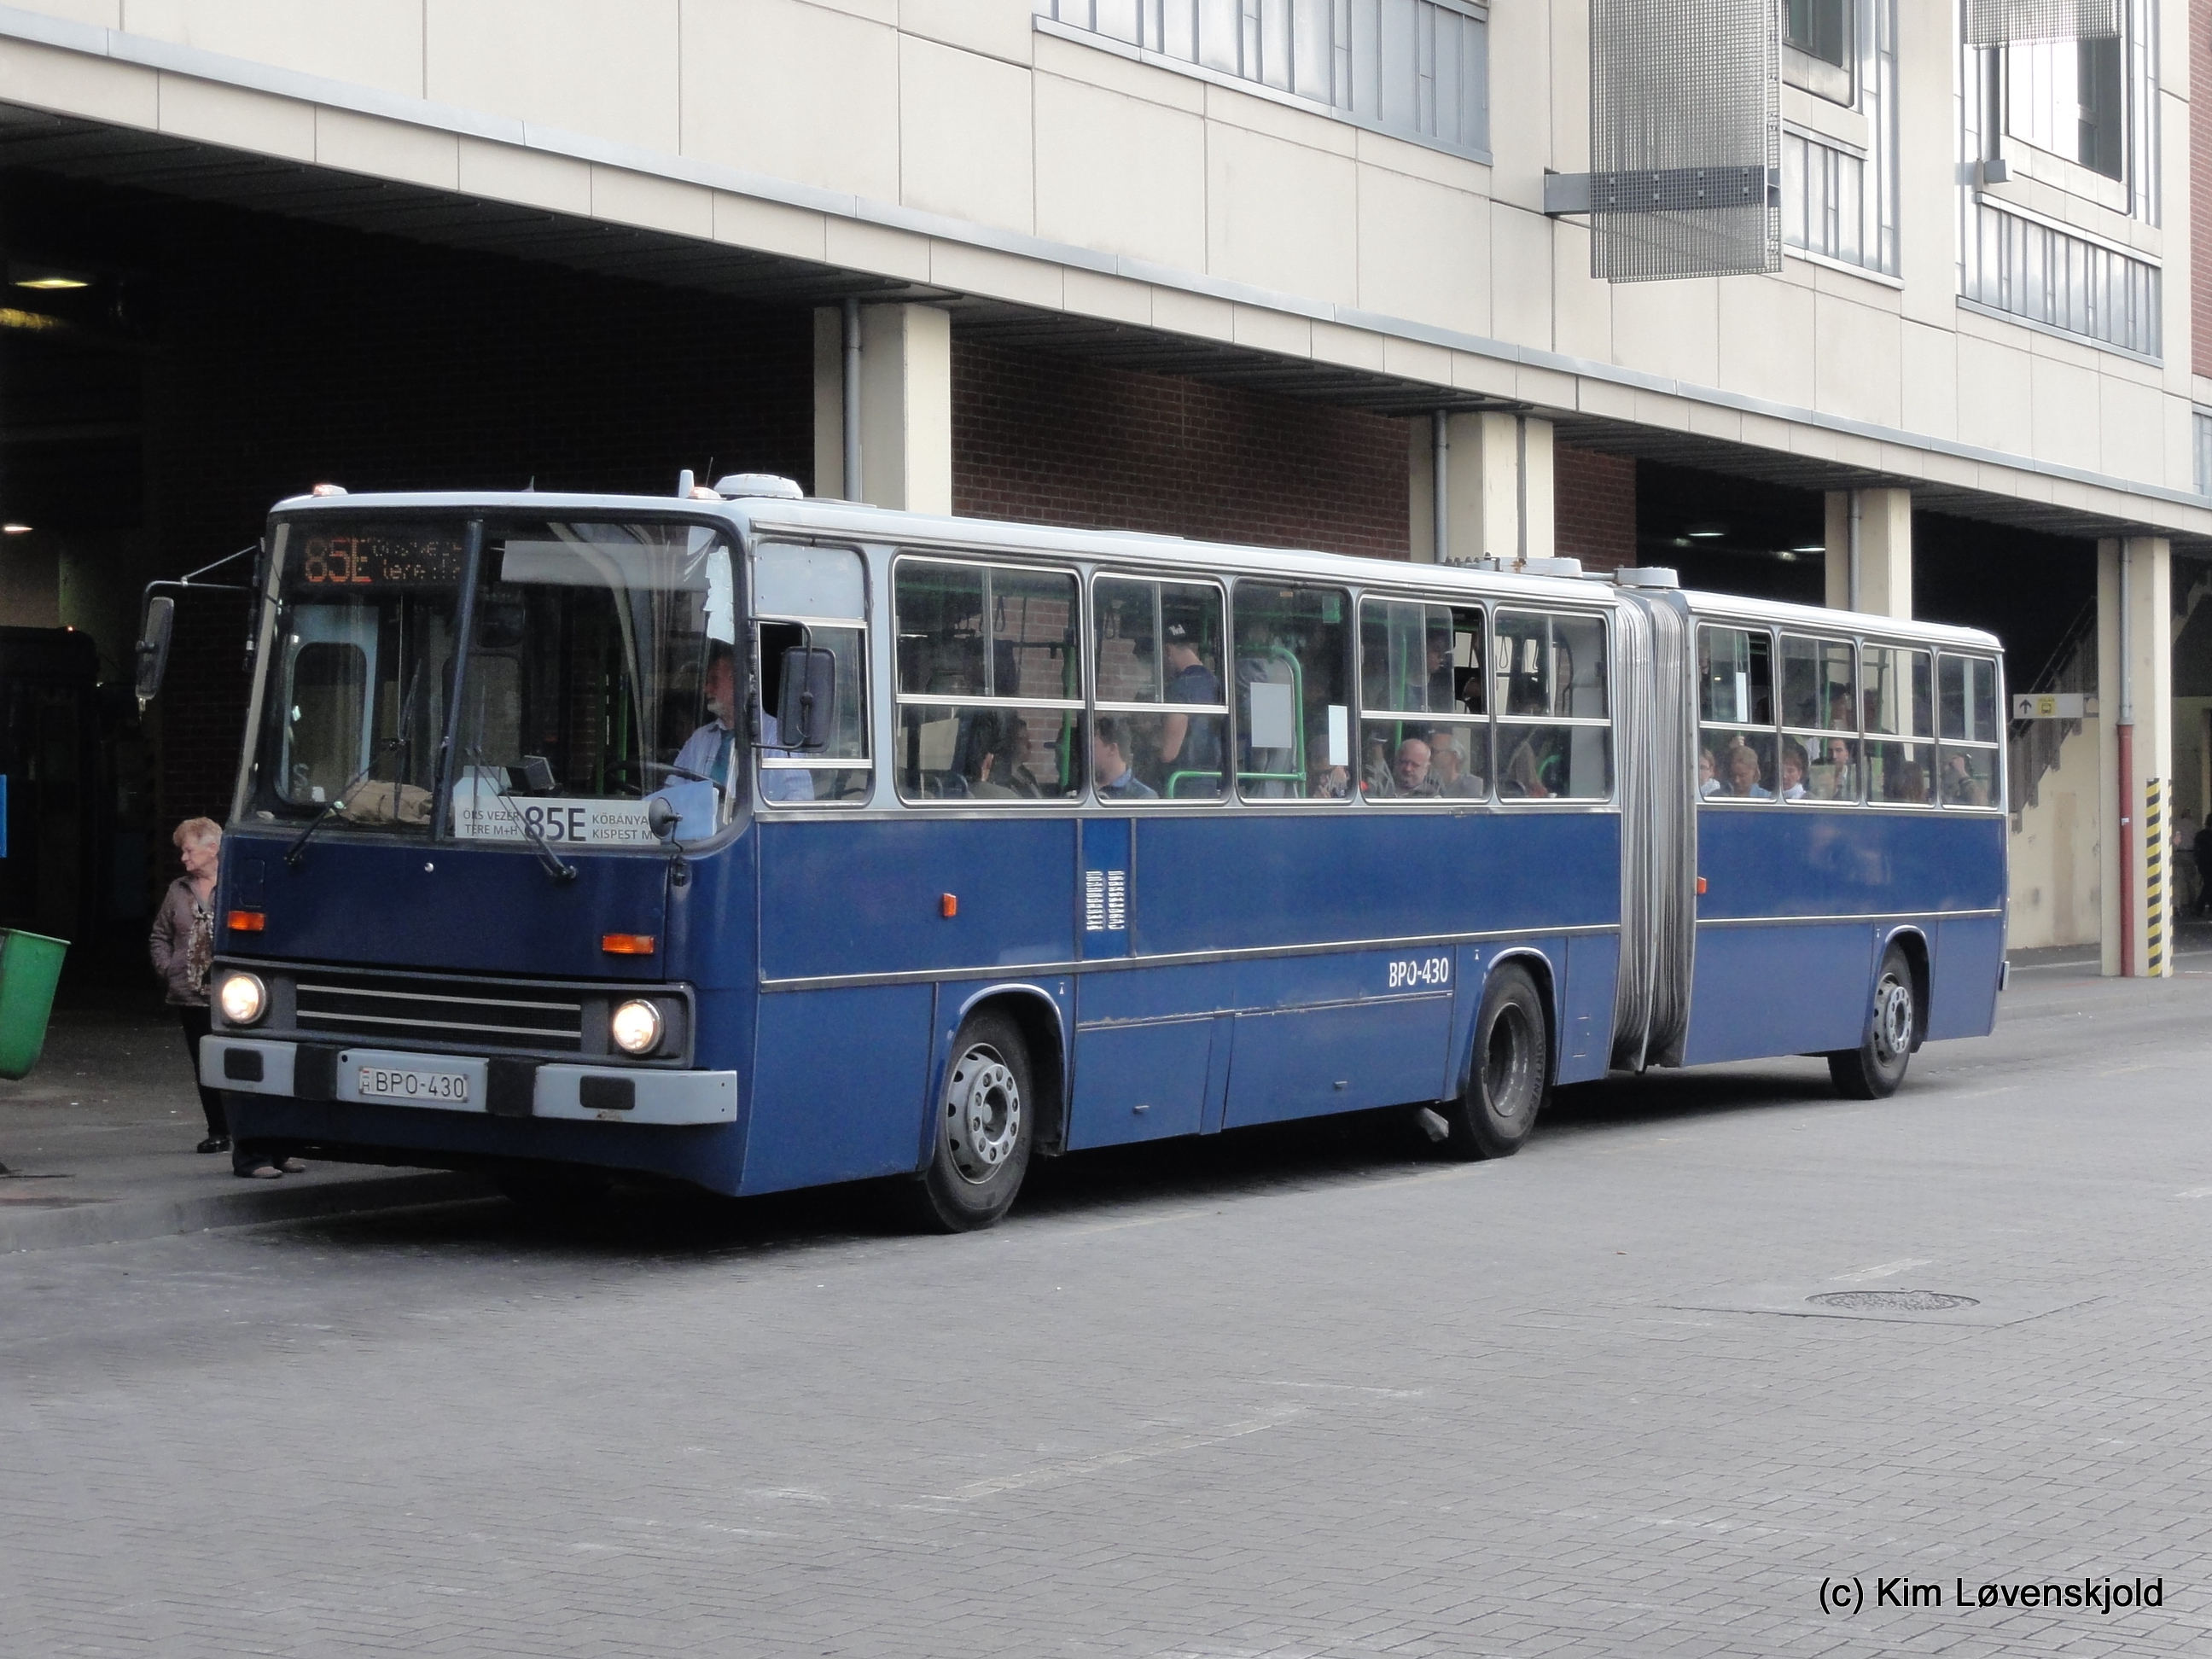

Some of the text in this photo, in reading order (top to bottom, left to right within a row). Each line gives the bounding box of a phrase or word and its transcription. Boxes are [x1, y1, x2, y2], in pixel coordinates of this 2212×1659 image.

[305, 538, 372, 583] 85E
[464, 824, 519, 835] TERE M+H
[524, 806, 586, 841] 85E
[592, 829, 637, 840] KISPEST
[1388, 957, 1449, 987] BPO-430
[376, 1071, 464, 1098] BPO-430
